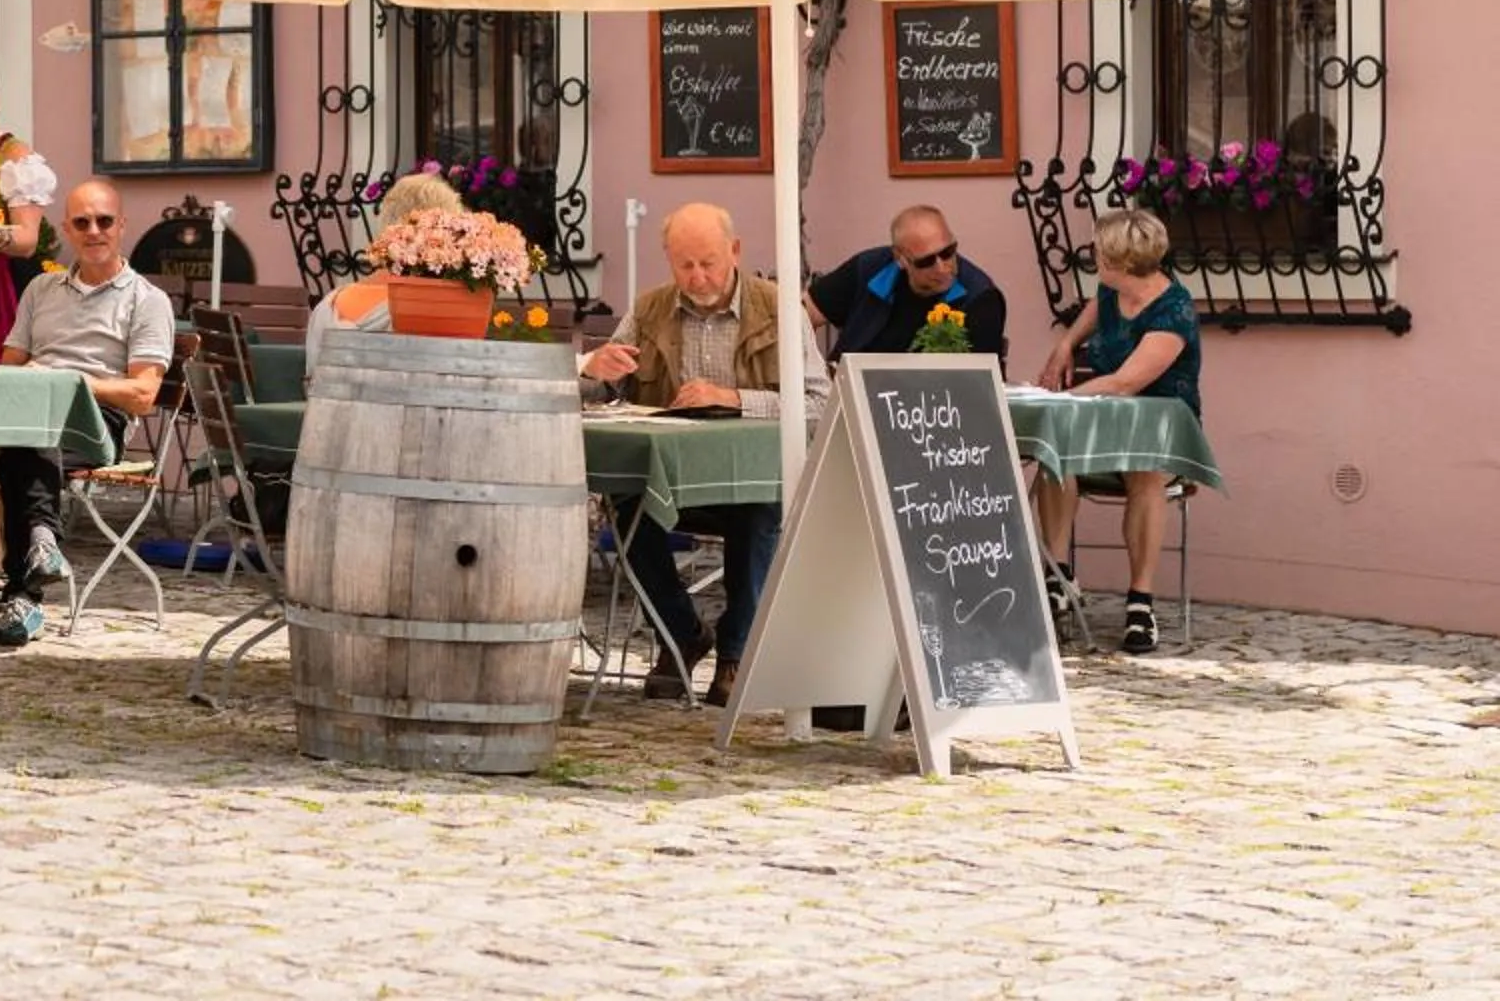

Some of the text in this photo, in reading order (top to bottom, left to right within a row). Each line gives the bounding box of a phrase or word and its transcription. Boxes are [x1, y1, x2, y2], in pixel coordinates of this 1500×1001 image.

[901, 15, 981, 48] Frische
[898, 54, 998, 81] Erdbeeren
[878, 388, 961, 444] Täglich
[922, 434, 991, 471] frischer
[925, 522, 1013, 588] Spargel
